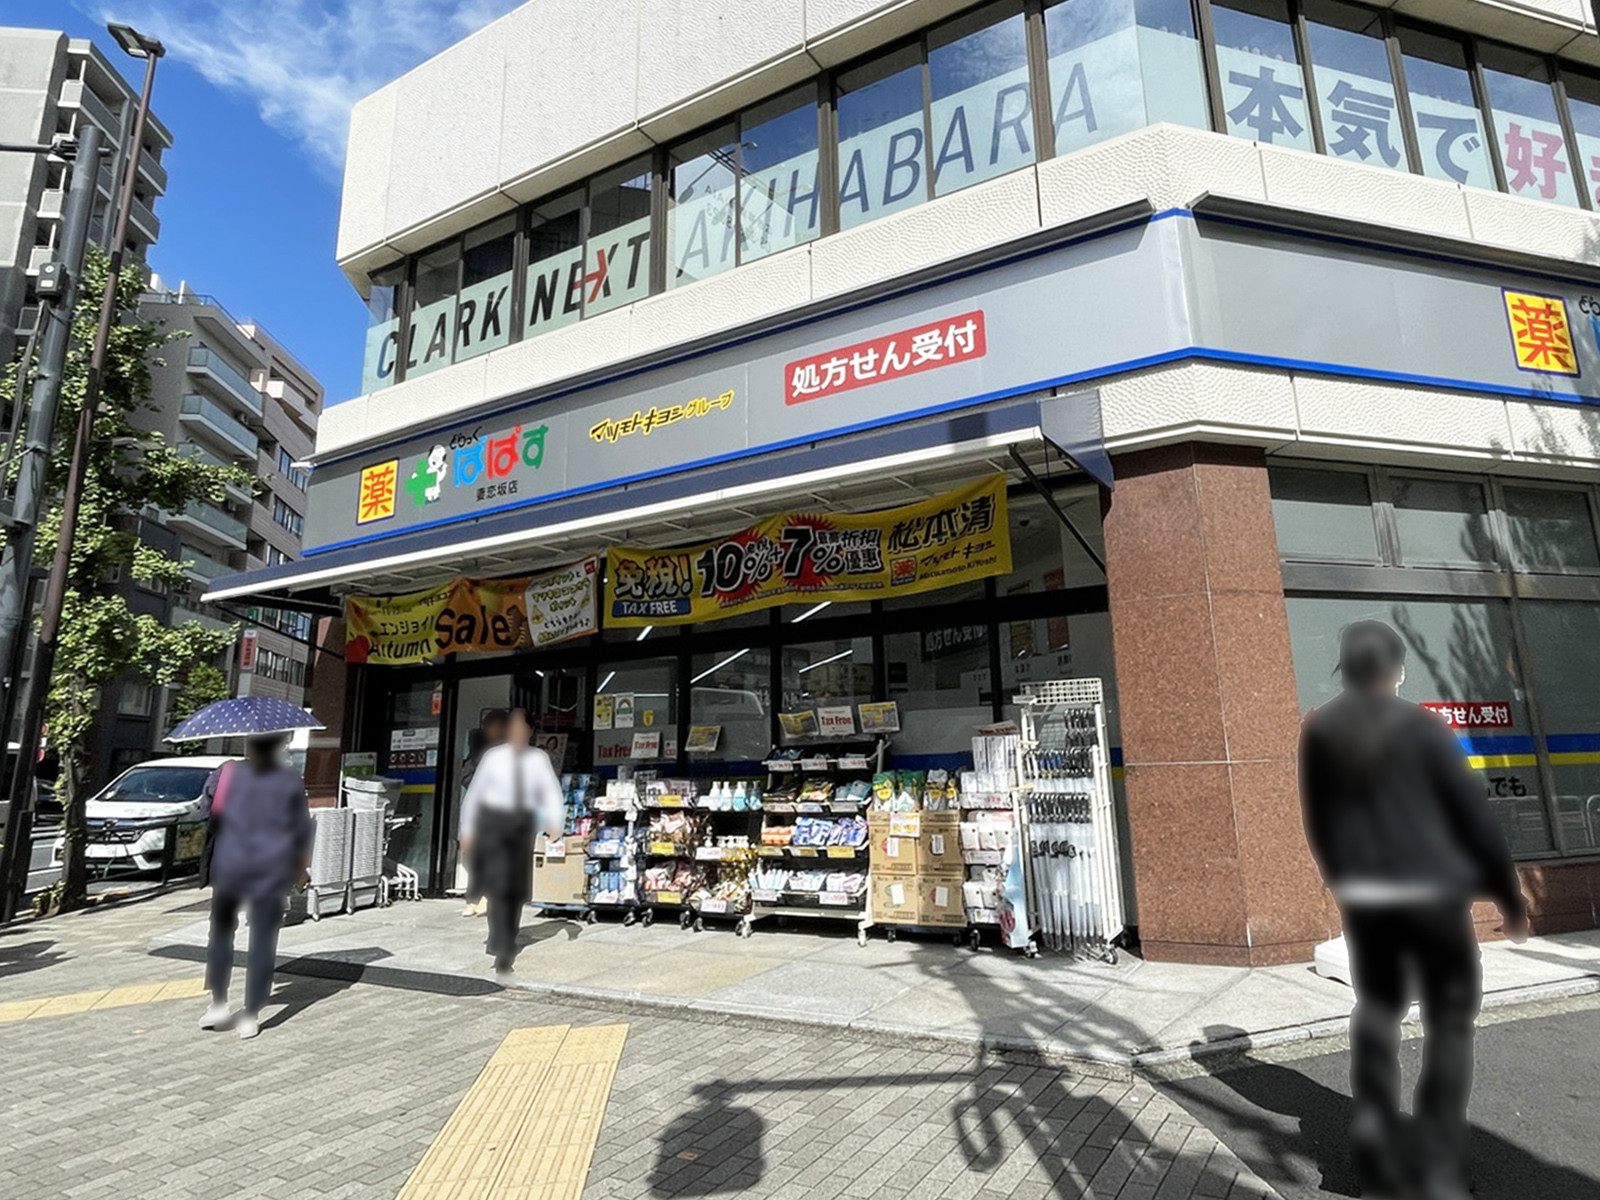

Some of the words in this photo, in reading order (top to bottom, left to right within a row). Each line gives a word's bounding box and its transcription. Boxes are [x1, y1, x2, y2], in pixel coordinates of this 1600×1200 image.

[1227, 66, 1600, 204] 本気で好
[376, 286, 508, 378] CLARK
[529, 231, 649, 326] NEXT
[676, 62, 1098, 277] AKIHABARA
[791, 319, 978, 398] 処方せん受付
[1511, 298, 1572, 369] 薬
[589, 389, 734, 443] マツモトキヨシグループ
[361, 465, 395, 519] 薬
[888, 493, 997, 555] 松本清
[435, 605, 510, 649] Sale
[622, 600, 648, 614] TAX
[650, 600, 678, 614] FREE
[1425, 706, 1509, 725] 方せん受付
[1488, 776, 1527, 798] でも
